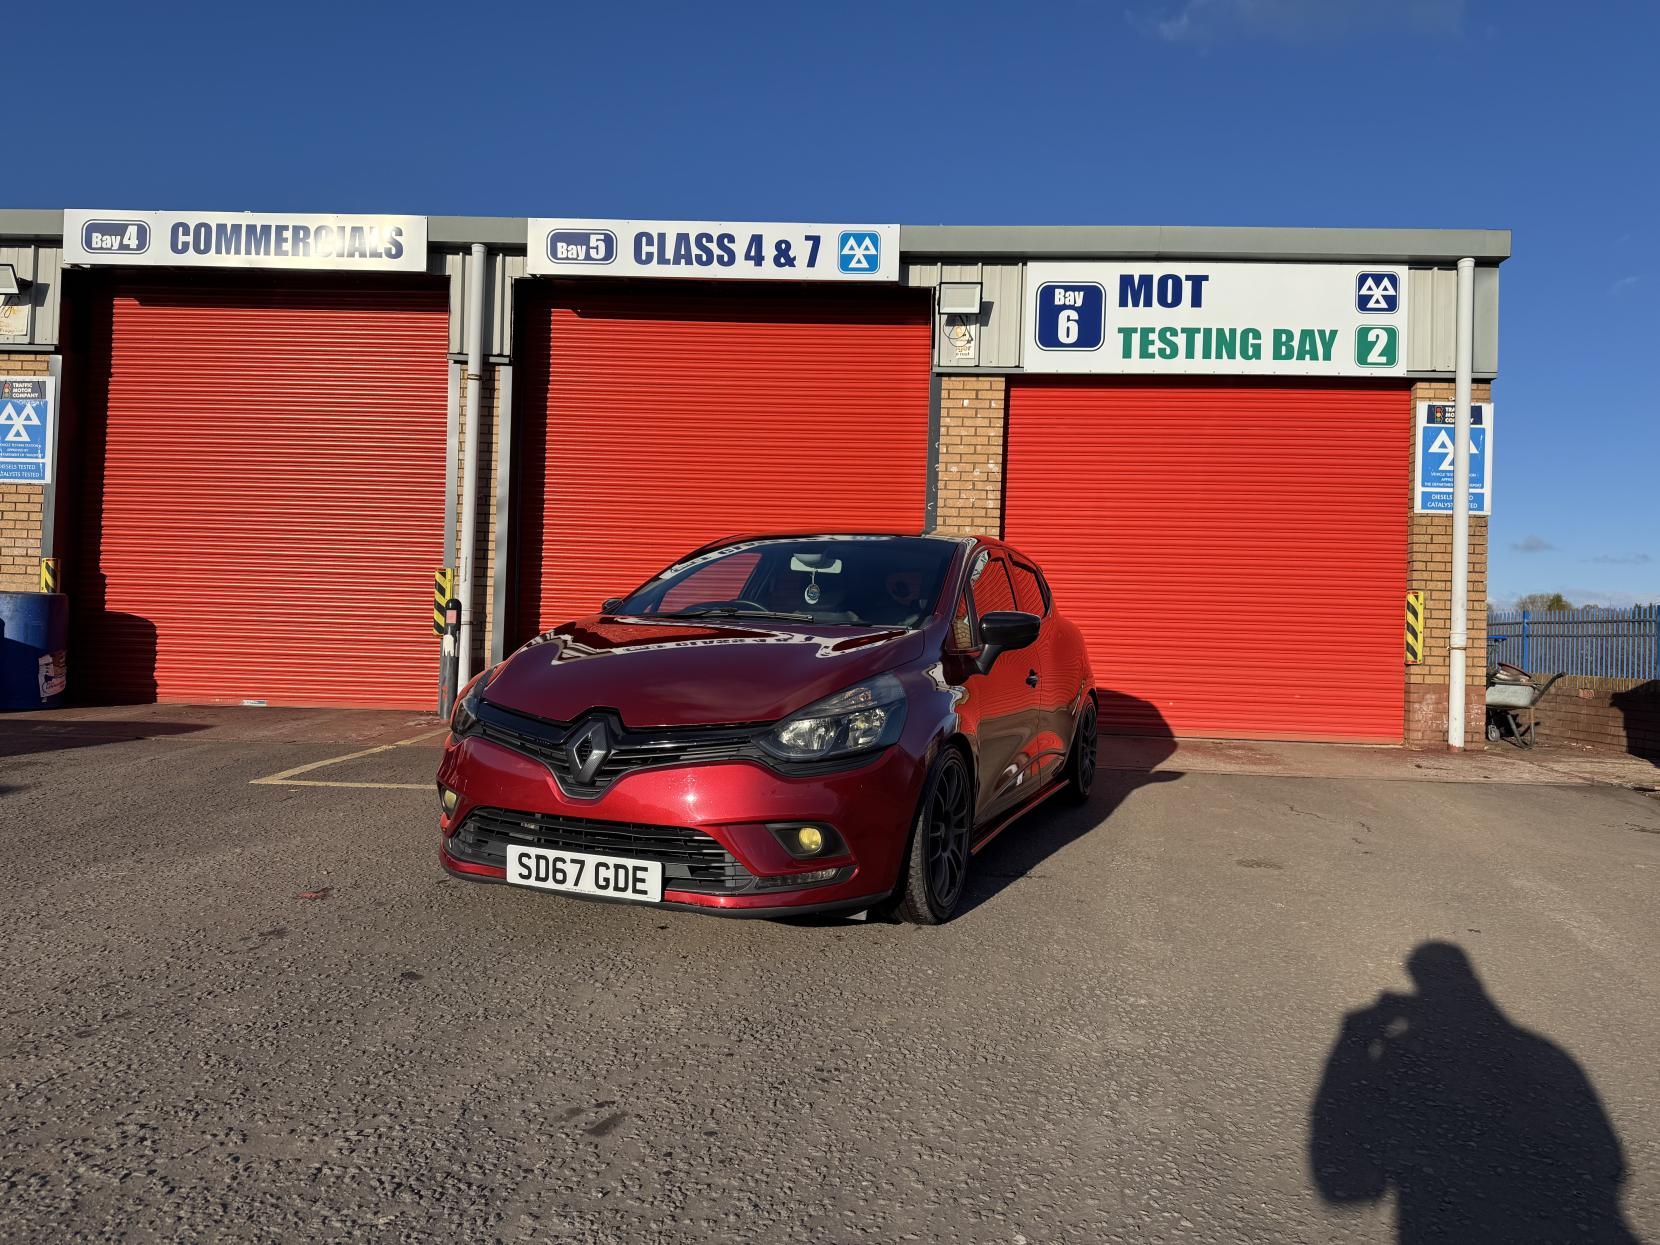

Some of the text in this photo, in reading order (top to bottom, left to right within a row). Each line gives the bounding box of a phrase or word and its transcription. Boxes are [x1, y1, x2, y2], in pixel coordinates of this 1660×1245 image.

[91, 225, 139, 250] Bay 4
[170, 222, 404, 260] COMMERCIALS
[556, 234, 606, 260] Bay 5
[633, 231, 822, 268] CLASS 4 & 7
[1054, 288, 1085, 307] Bay
[1118, 273, 1209, 309] MOT
[1057, 309, 1079, 345] 6
[1117, 326, 1339, 362] TESTING BAY
[1366, 328, 1388, 364] 2
[517, 852, 649, 896] SD67 GDE
